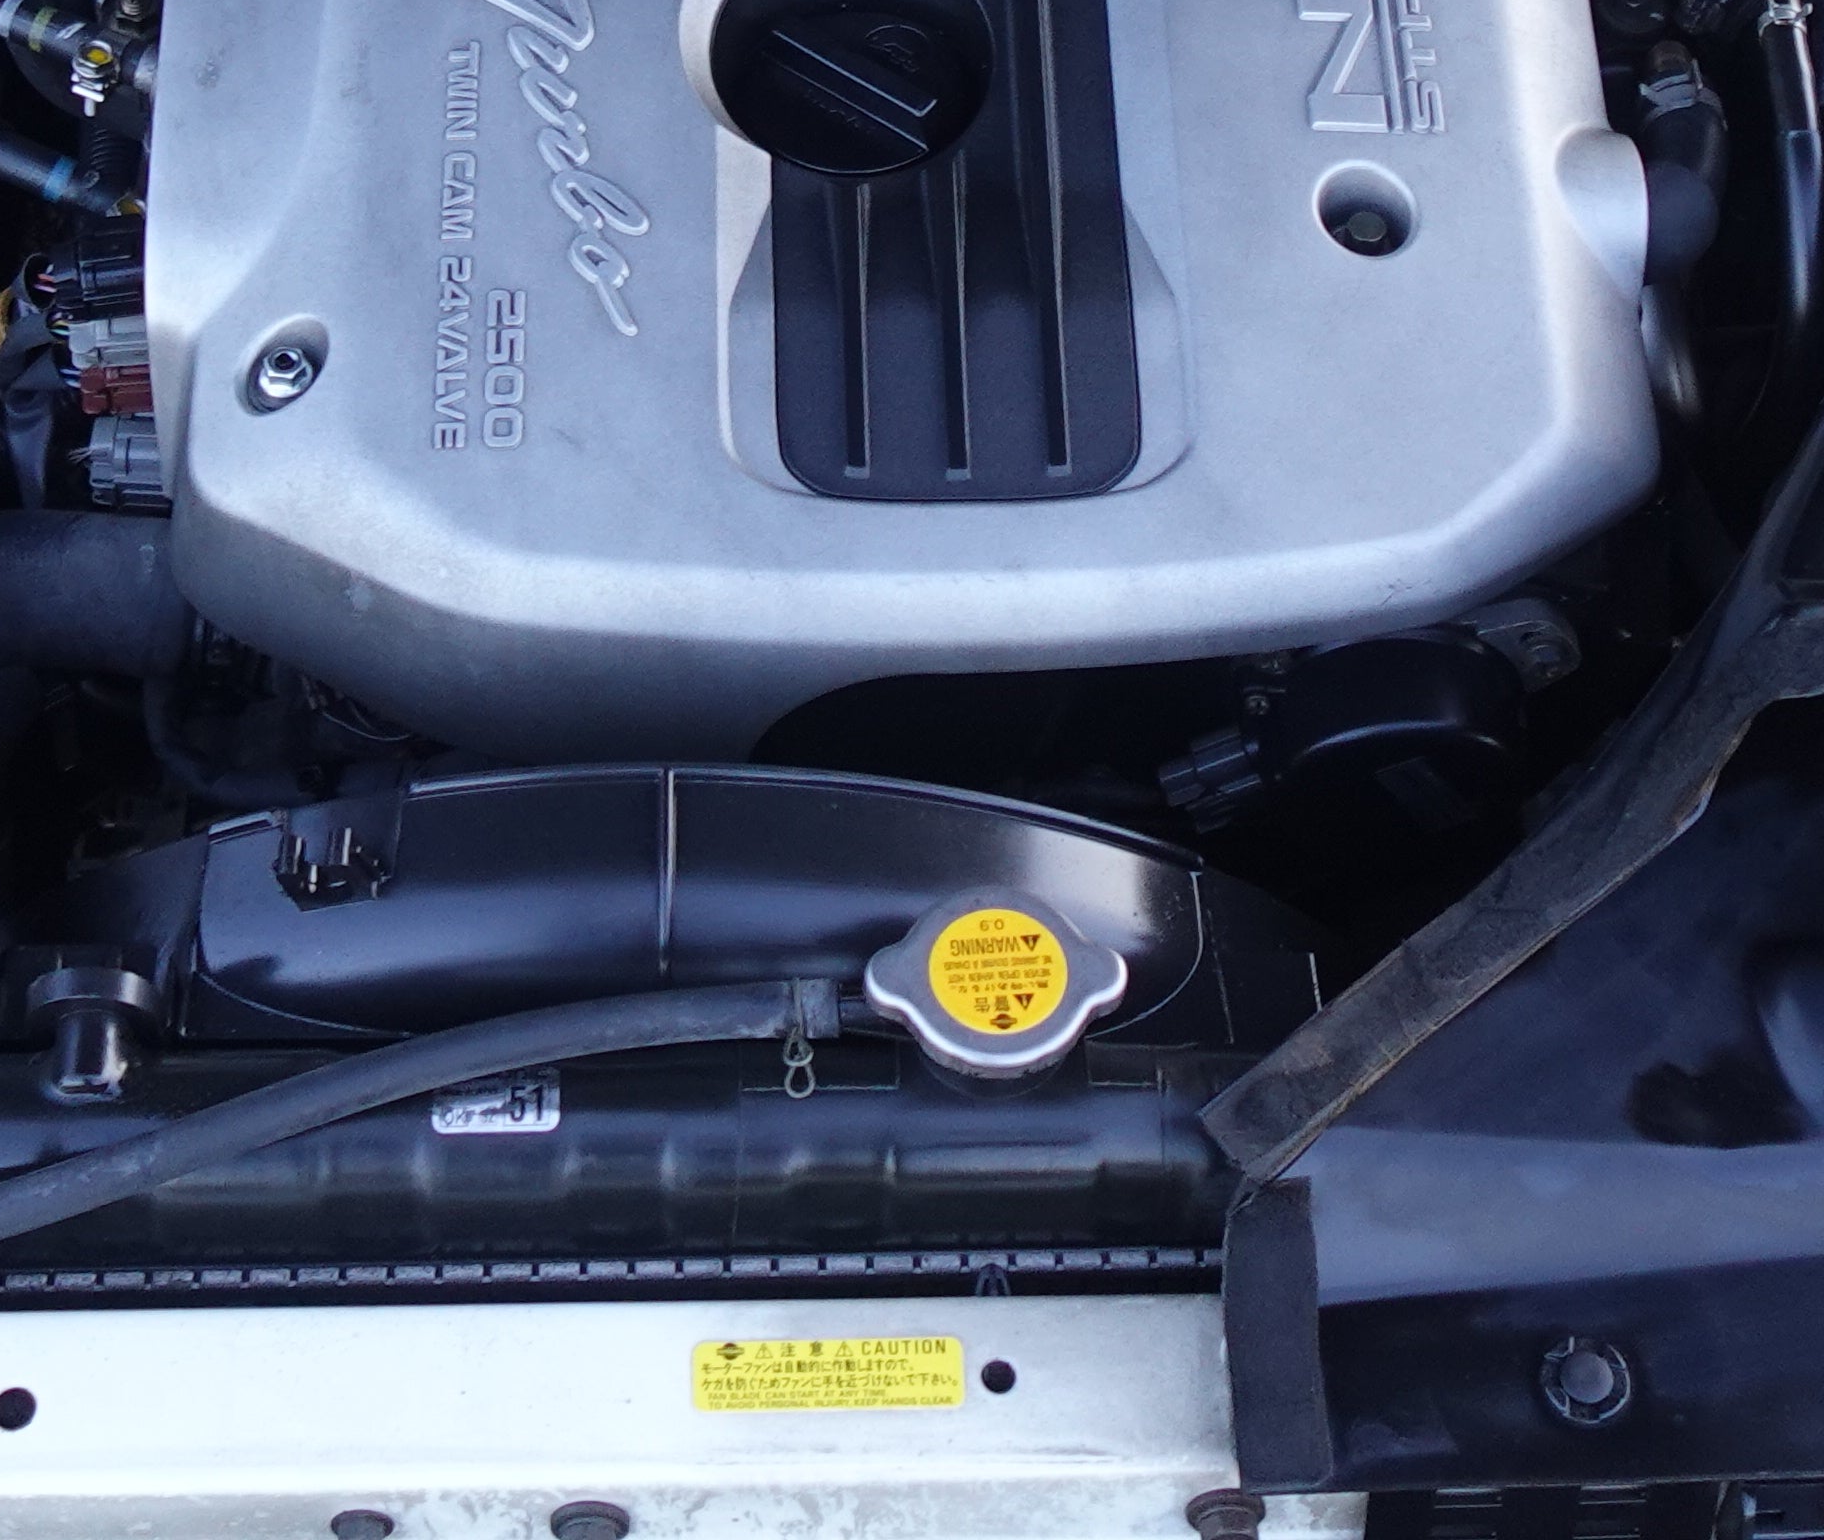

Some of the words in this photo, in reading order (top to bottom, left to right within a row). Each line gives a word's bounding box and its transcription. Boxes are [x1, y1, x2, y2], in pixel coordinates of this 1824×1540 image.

[444, 39, 481, 141] TWIN
[440, 152, 478, 242] CAM
[432, 256, 473, 451] 24VALVE
[482, 289, 527, 450] 2500
[950, 936, 1021, 957] WARNING
[861, 1339, 947, 1356] CAUTION
